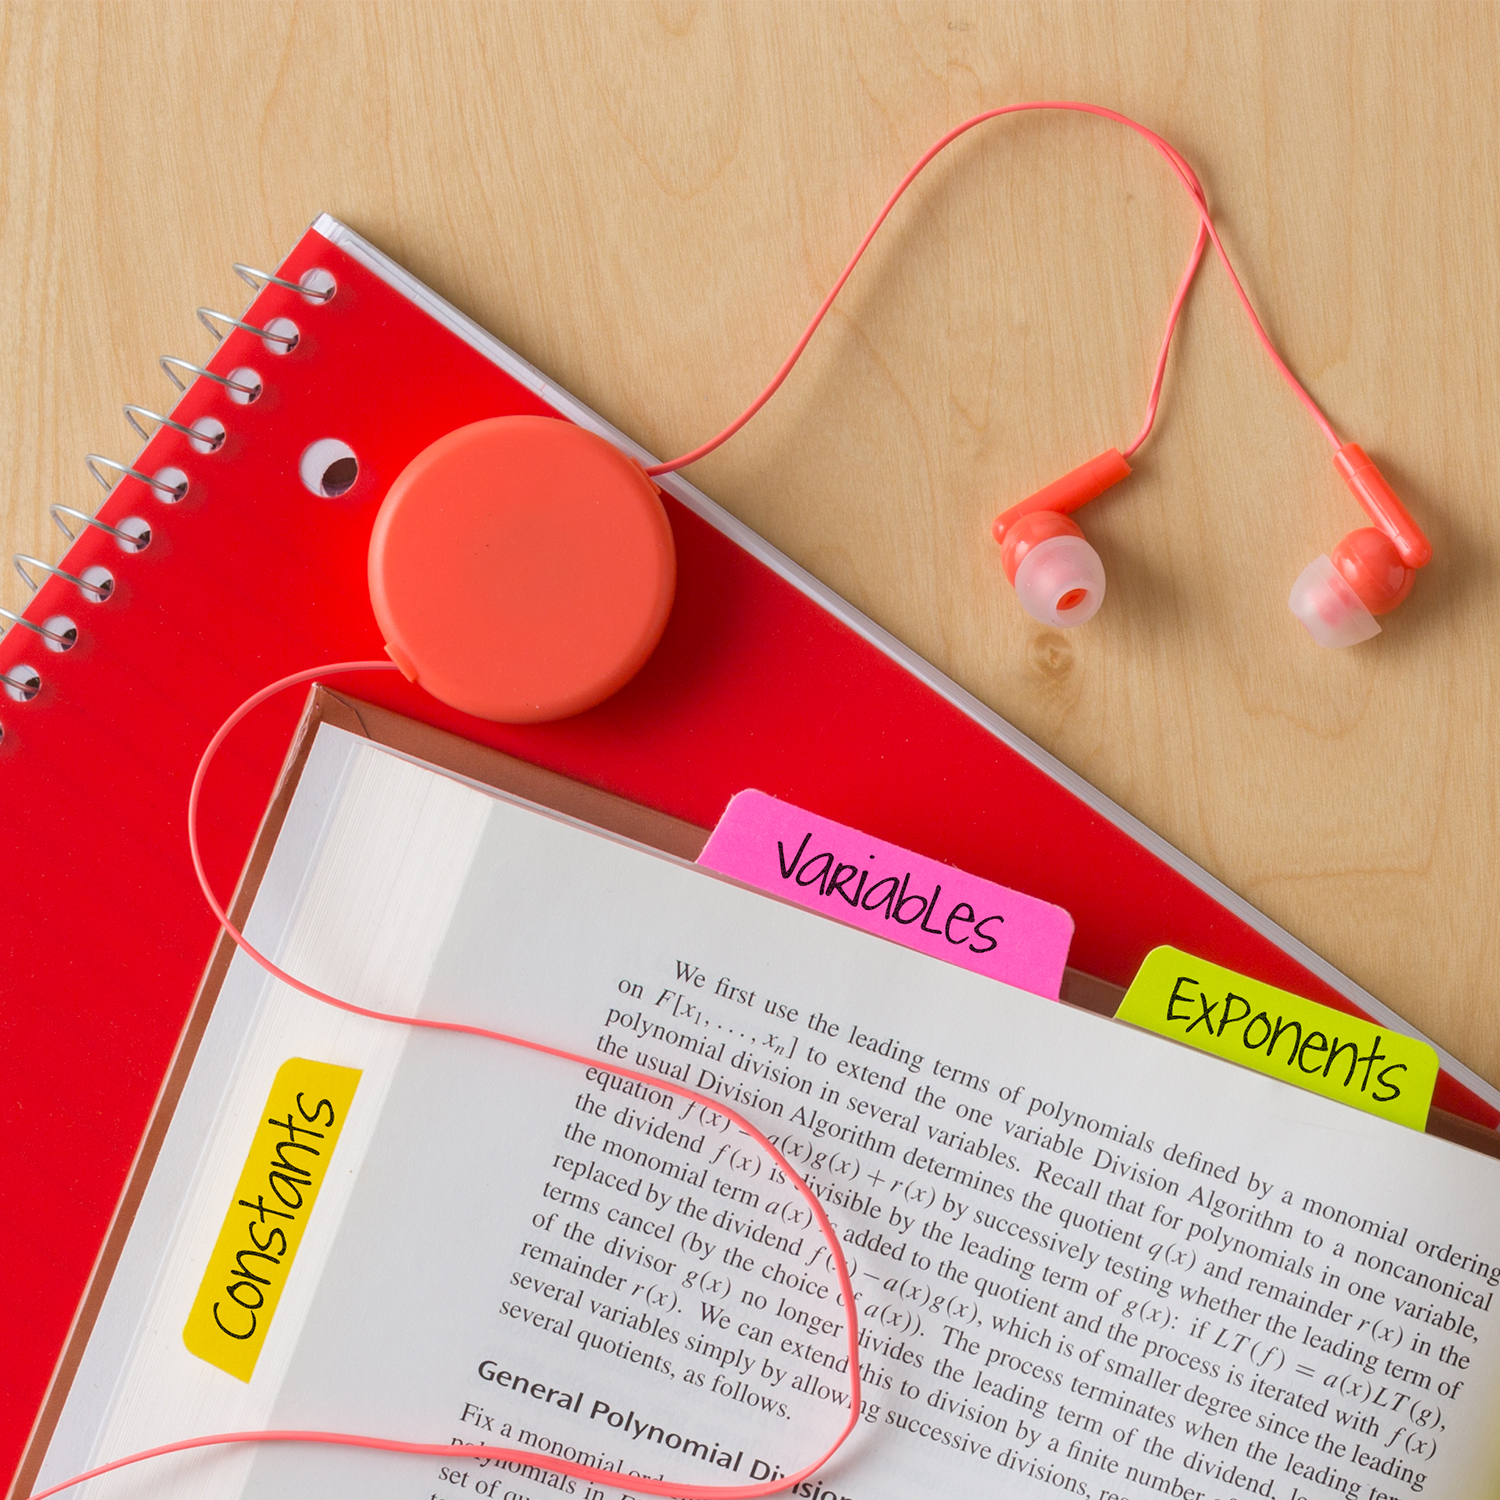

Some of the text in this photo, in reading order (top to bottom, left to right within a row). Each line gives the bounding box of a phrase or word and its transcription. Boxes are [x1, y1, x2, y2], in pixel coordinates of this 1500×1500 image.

[214, 1093, 334, 1340] Constants
[617, 979, 1494, 1313] on to extend the one variable Division Algorithm to a noncanonical
[675, 959, 706, 989] We
[713, 976, 757, 1008] first
[764, 999, 799, 1023] use
[807, 1012, 840, 1038] the
[847, 1024, 926, 1074] leading
[932, 1059, 990, 1094] terms
[998, 1085, 1026, 1105] of
[1025, 1097, 1155, 1154] polynomials
[1162, 1142, 1241, 1185] defined
[1246, 1171, 1274, 1201] by
[1280, 1190, 1294, 1206] a
[1301, 1197, 1409, 1248] monomial
[477, 1359, 585, 1414] General
[589, 1399, 744, 1473] Polynomial
